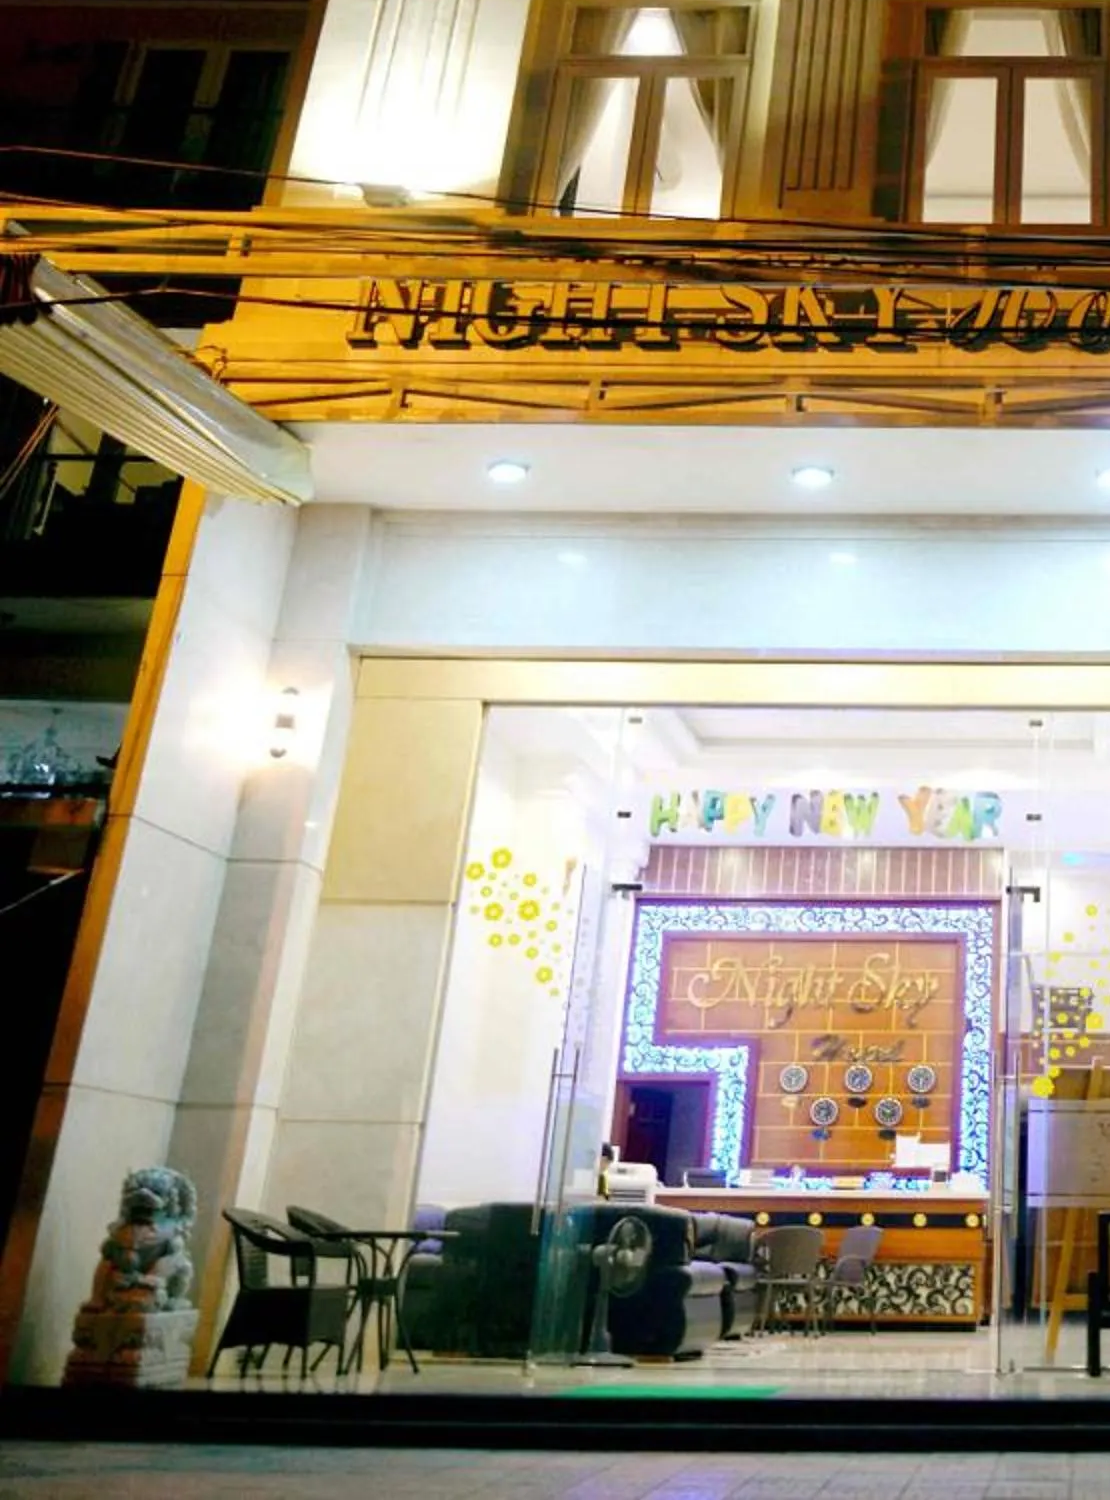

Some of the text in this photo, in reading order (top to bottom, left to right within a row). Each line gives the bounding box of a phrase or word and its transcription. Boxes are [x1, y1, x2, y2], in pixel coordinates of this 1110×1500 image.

[346, 278, 682, 352] NIGHT
[650, 786, 1003, 841] HAPPY NEW YEAR
[687, 952, 940, 1030] Night Sky
